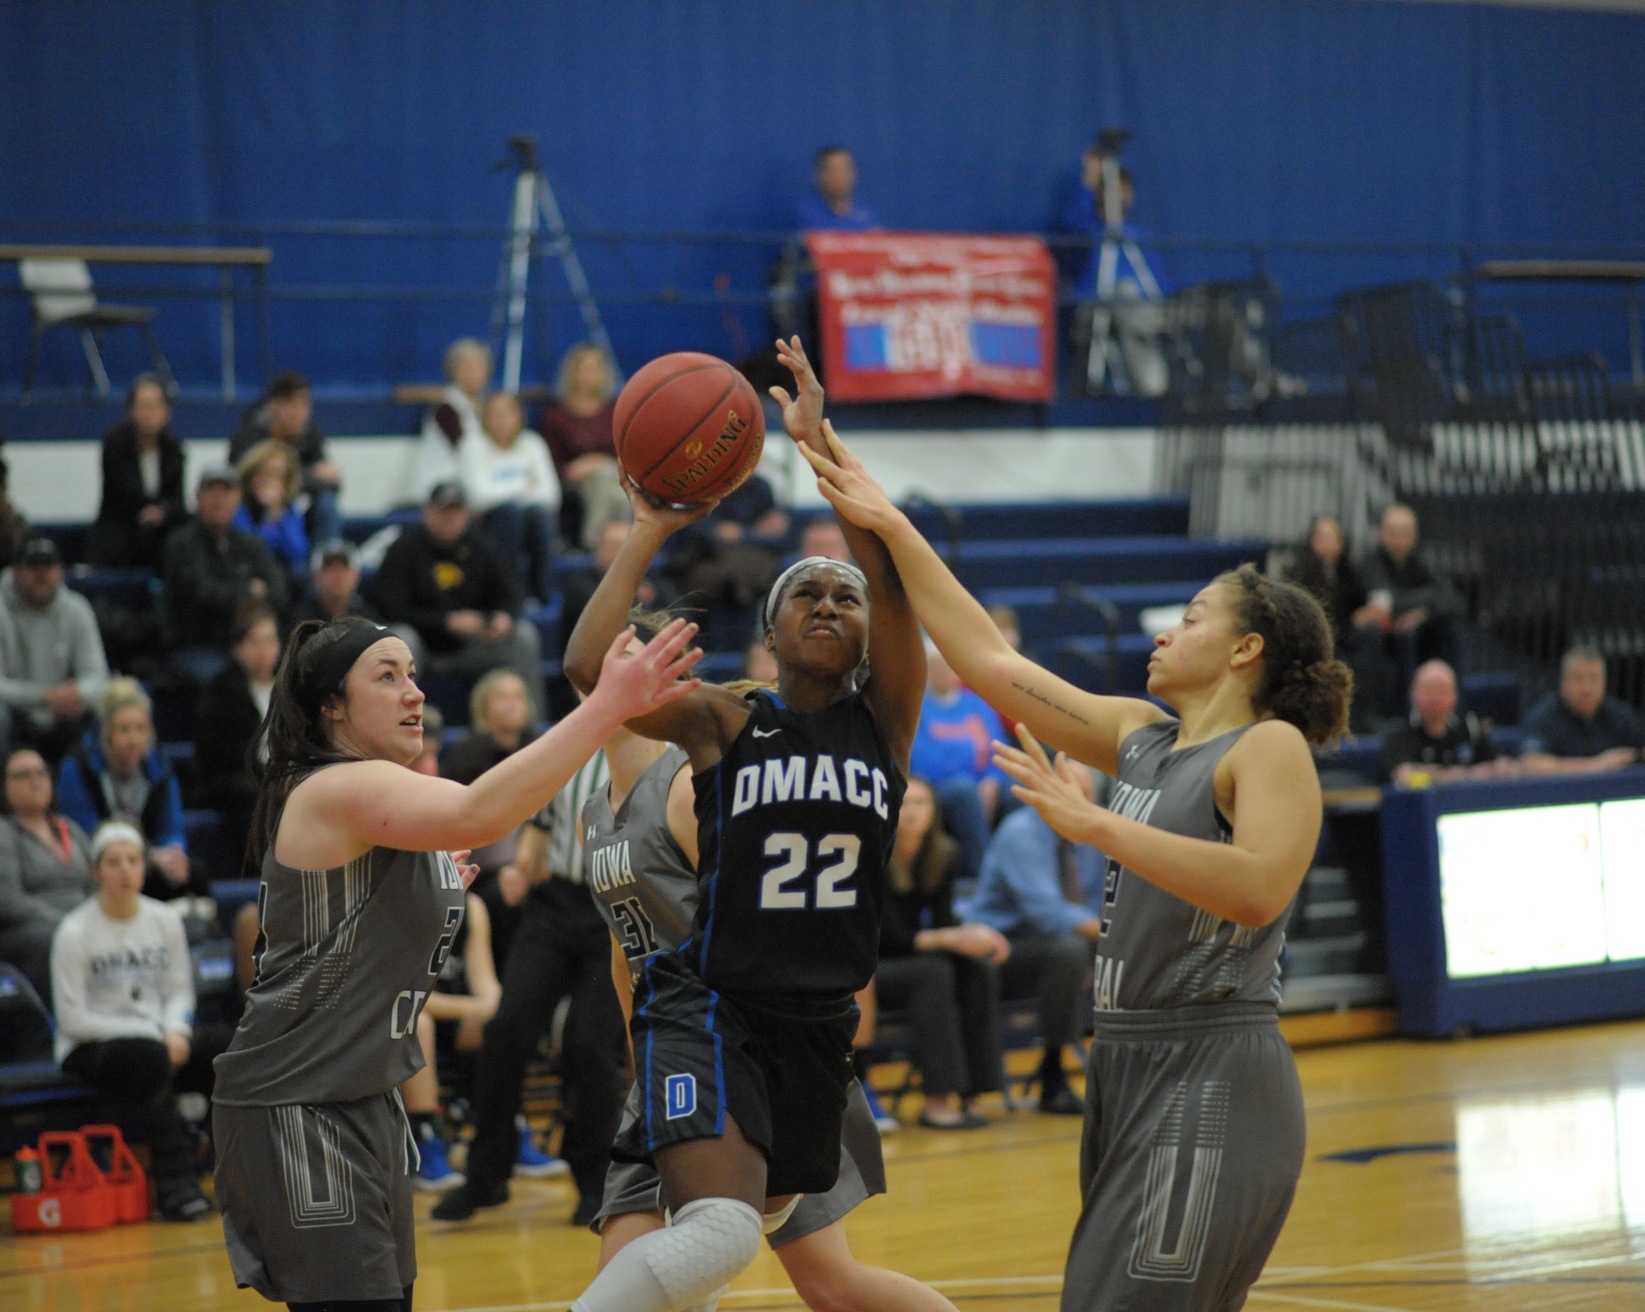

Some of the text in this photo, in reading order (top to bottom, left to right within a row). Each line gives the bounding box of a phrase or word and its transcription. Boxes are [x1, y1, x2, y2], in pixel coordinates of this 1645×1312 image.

[661, 409, 748, 492] SPALDING
[731, 754, 888, 820] DMACC
[592, 840, 637, 893] IOWA
[761, 832, 861, 909] 22
[610, 896, 661, 960] 31
[665, 1073, 697, 1120] D
